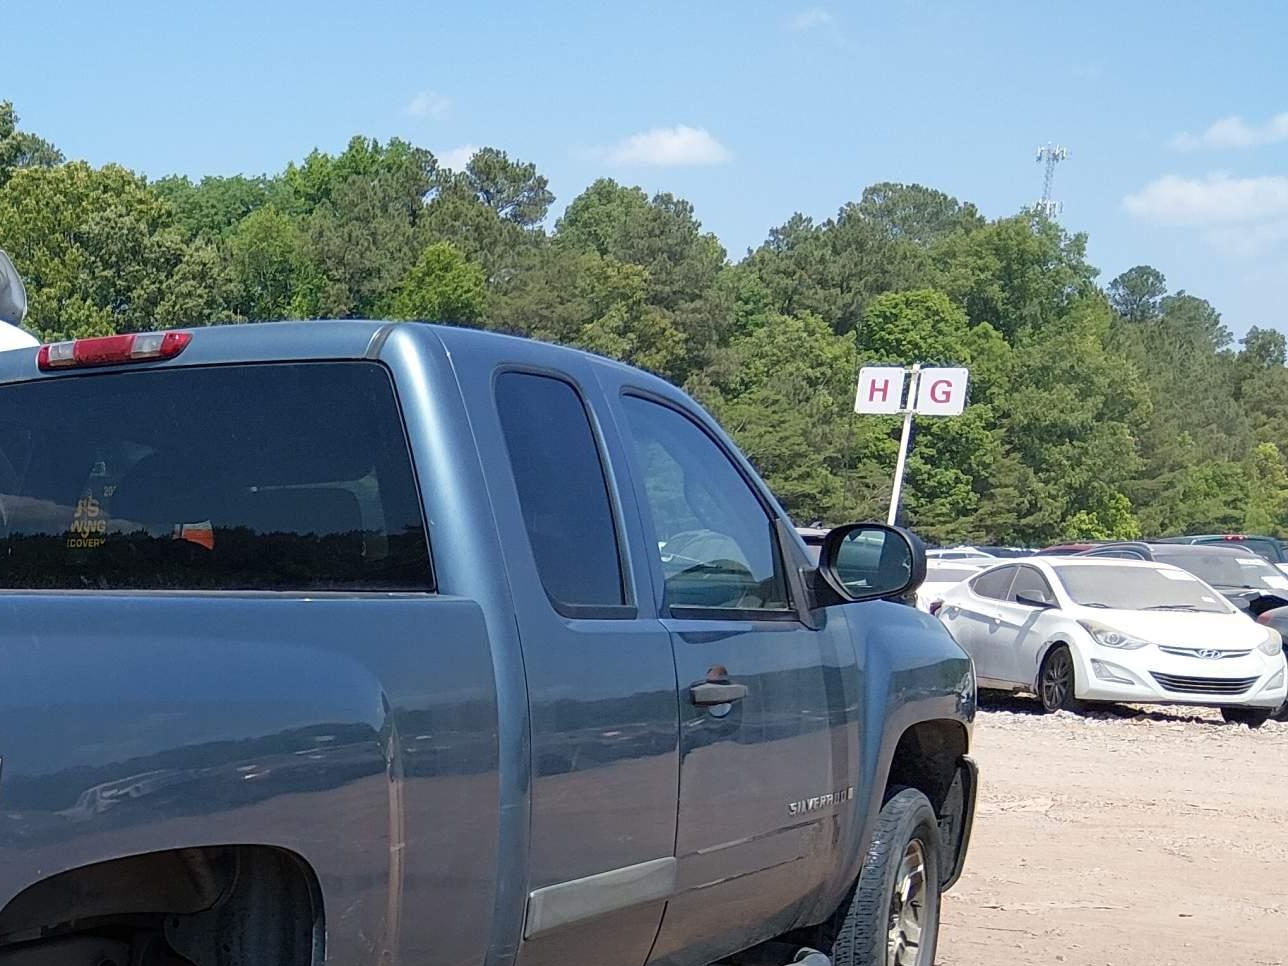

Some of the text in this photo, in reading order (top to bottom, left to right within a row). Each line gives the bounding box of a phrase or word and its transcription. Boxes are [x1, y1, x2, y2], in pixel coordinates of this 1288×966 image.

[868, 378, 890, 402] H
[929, 379, 954, 404] G
[788, 790, 847, 816] SILVERADO
